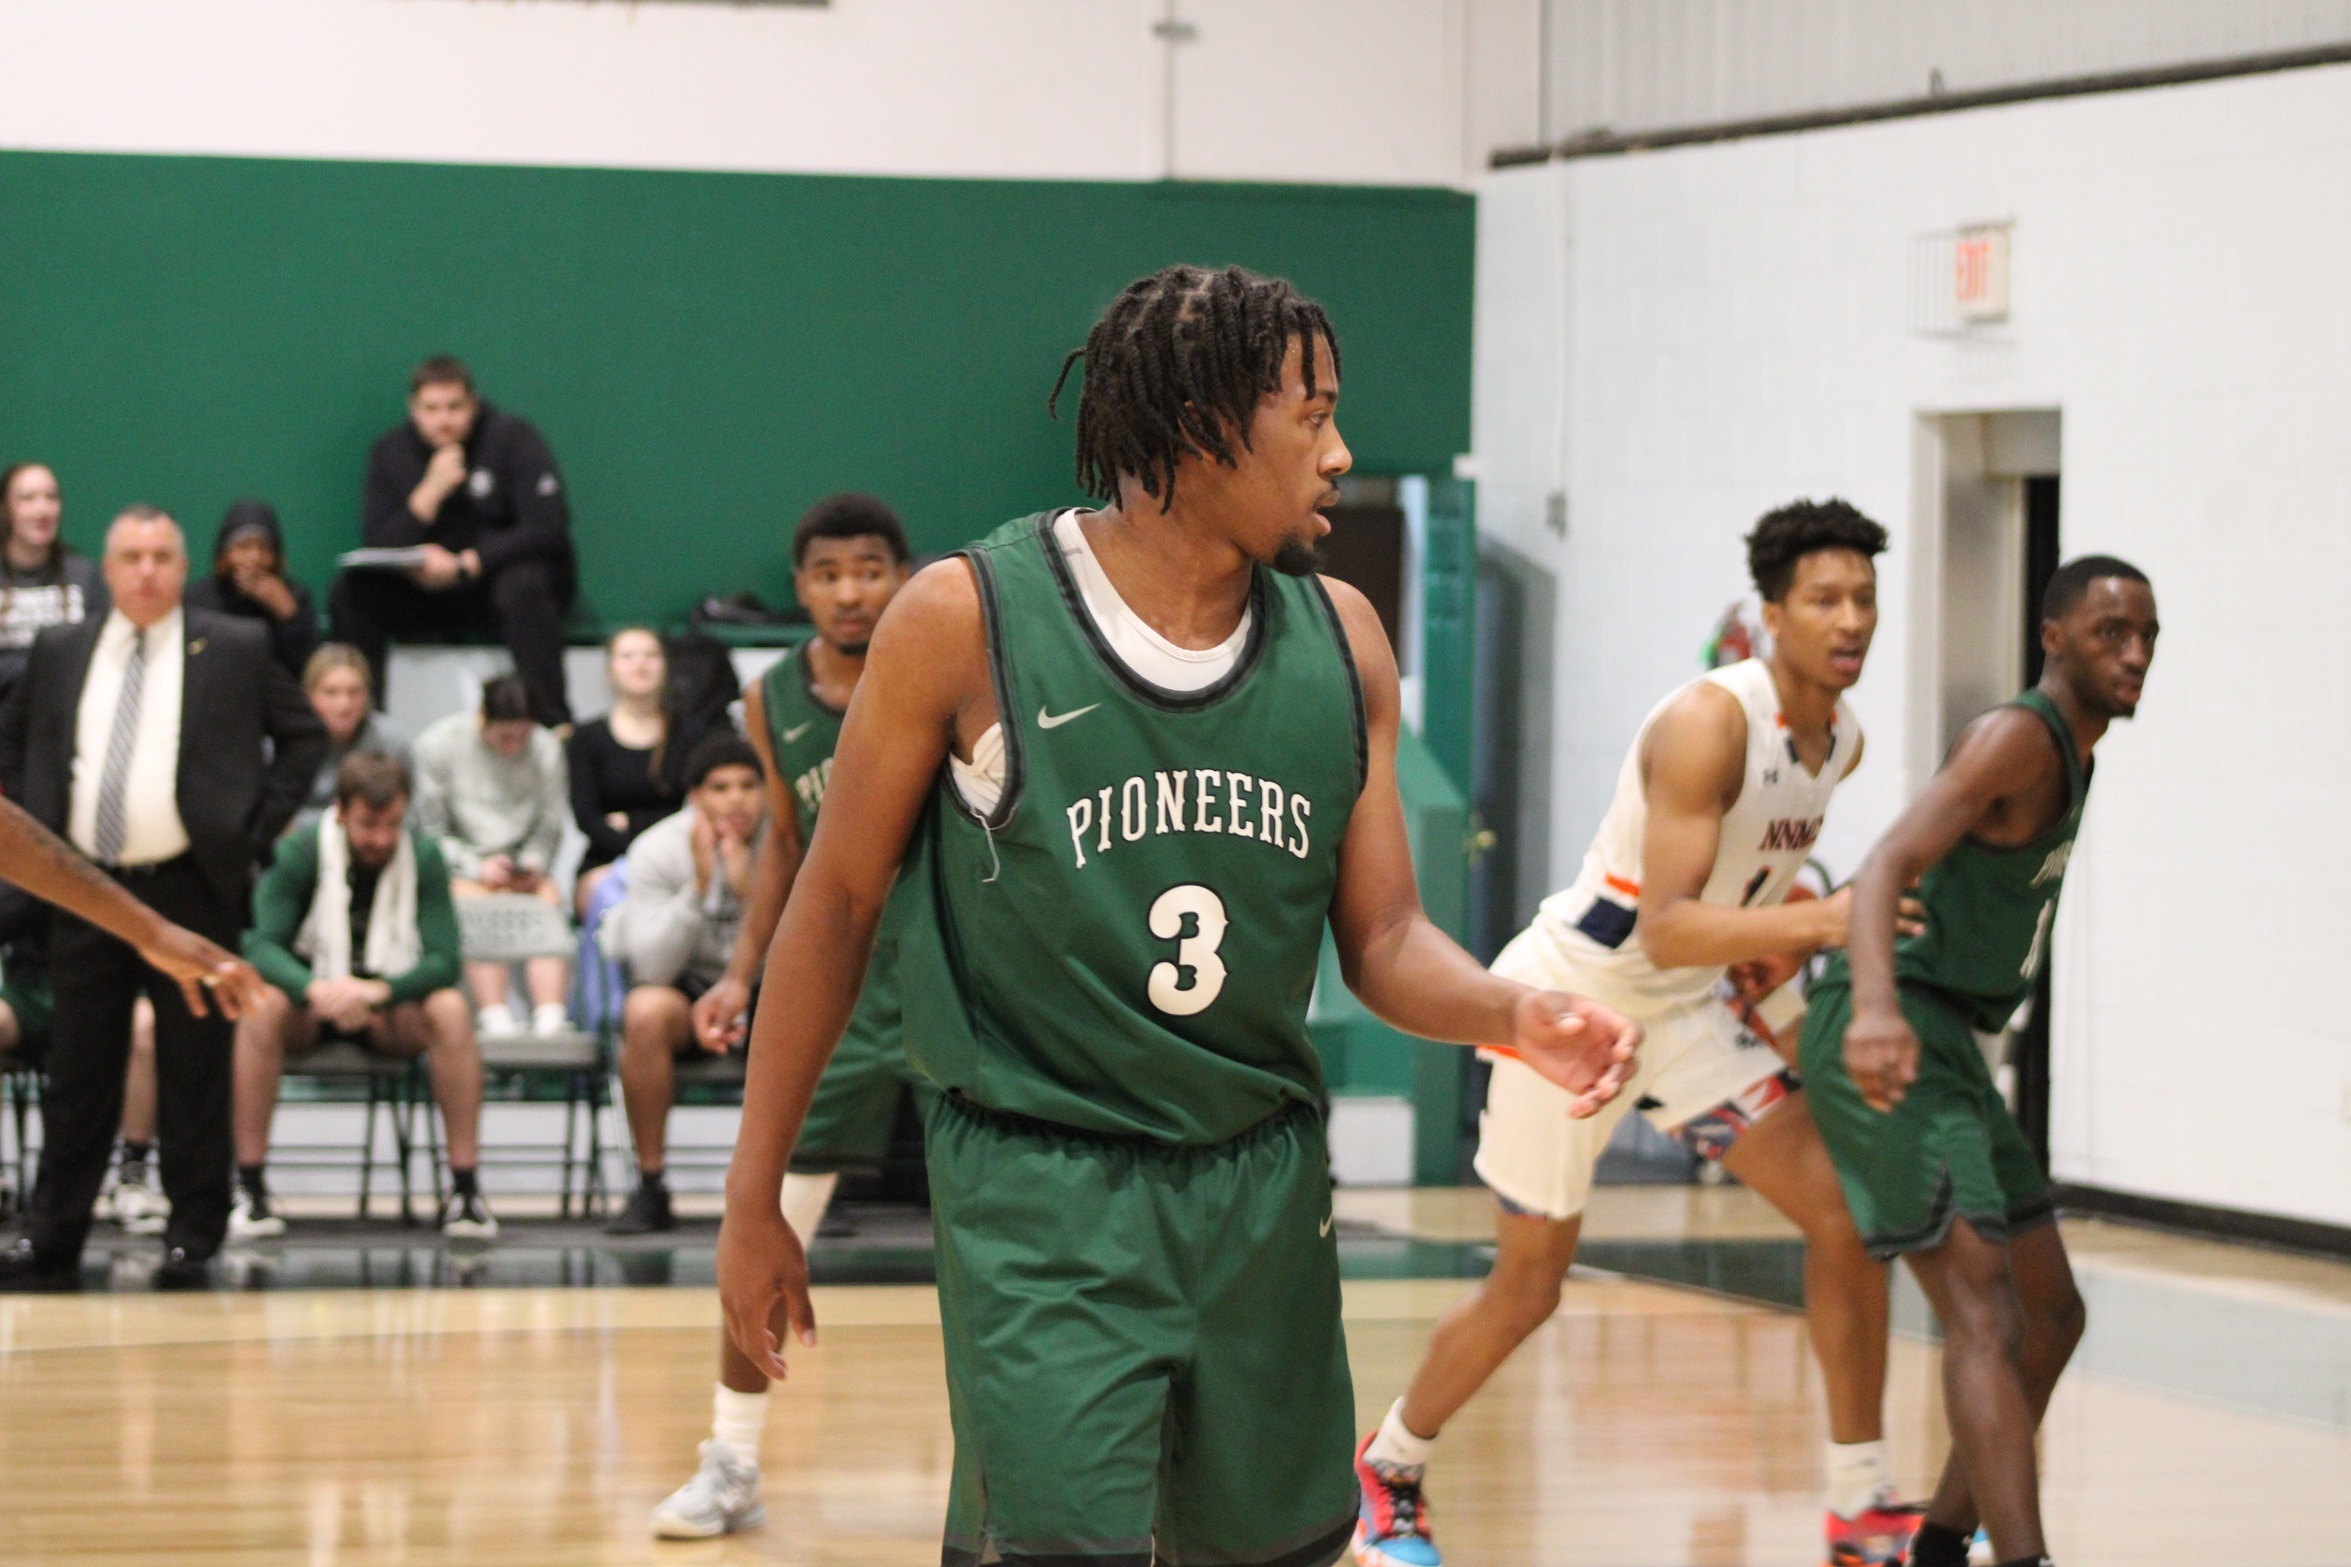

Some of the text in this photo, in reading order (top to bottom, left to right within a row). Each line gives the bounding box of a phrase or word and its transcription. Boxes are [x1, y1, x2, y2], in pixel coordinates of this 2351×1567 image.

[1955, 241, 1989, 302] EXIT
[1066, 768, 1311, 869] PIONEERS
[1147, 883, 1229, 1016] 3
